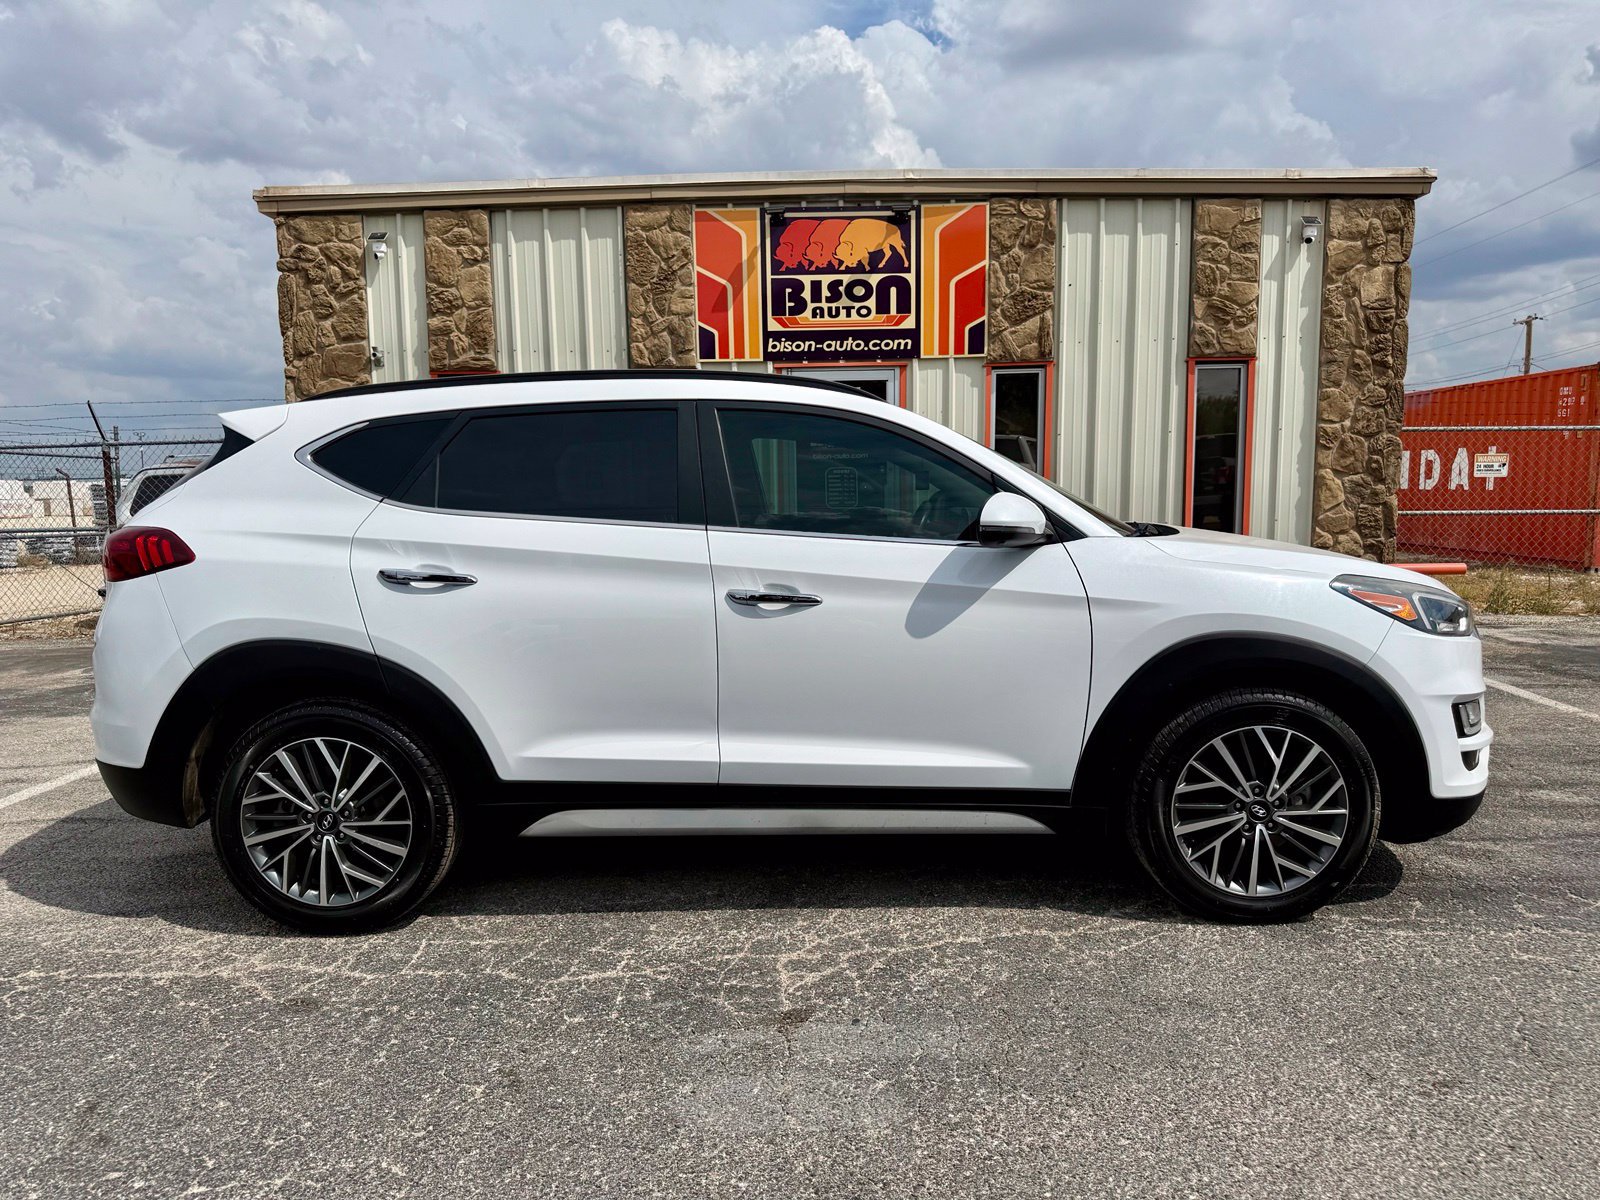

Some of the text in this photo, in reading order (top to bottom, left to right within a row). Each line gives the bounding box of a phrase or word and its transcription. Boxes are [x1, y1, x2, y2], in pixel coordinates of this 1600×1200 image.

[771, 275, 911, 317] BISON
[811, 305, 872, 319] AUTO
[767, 337, 912, 353] bison-auto.com
